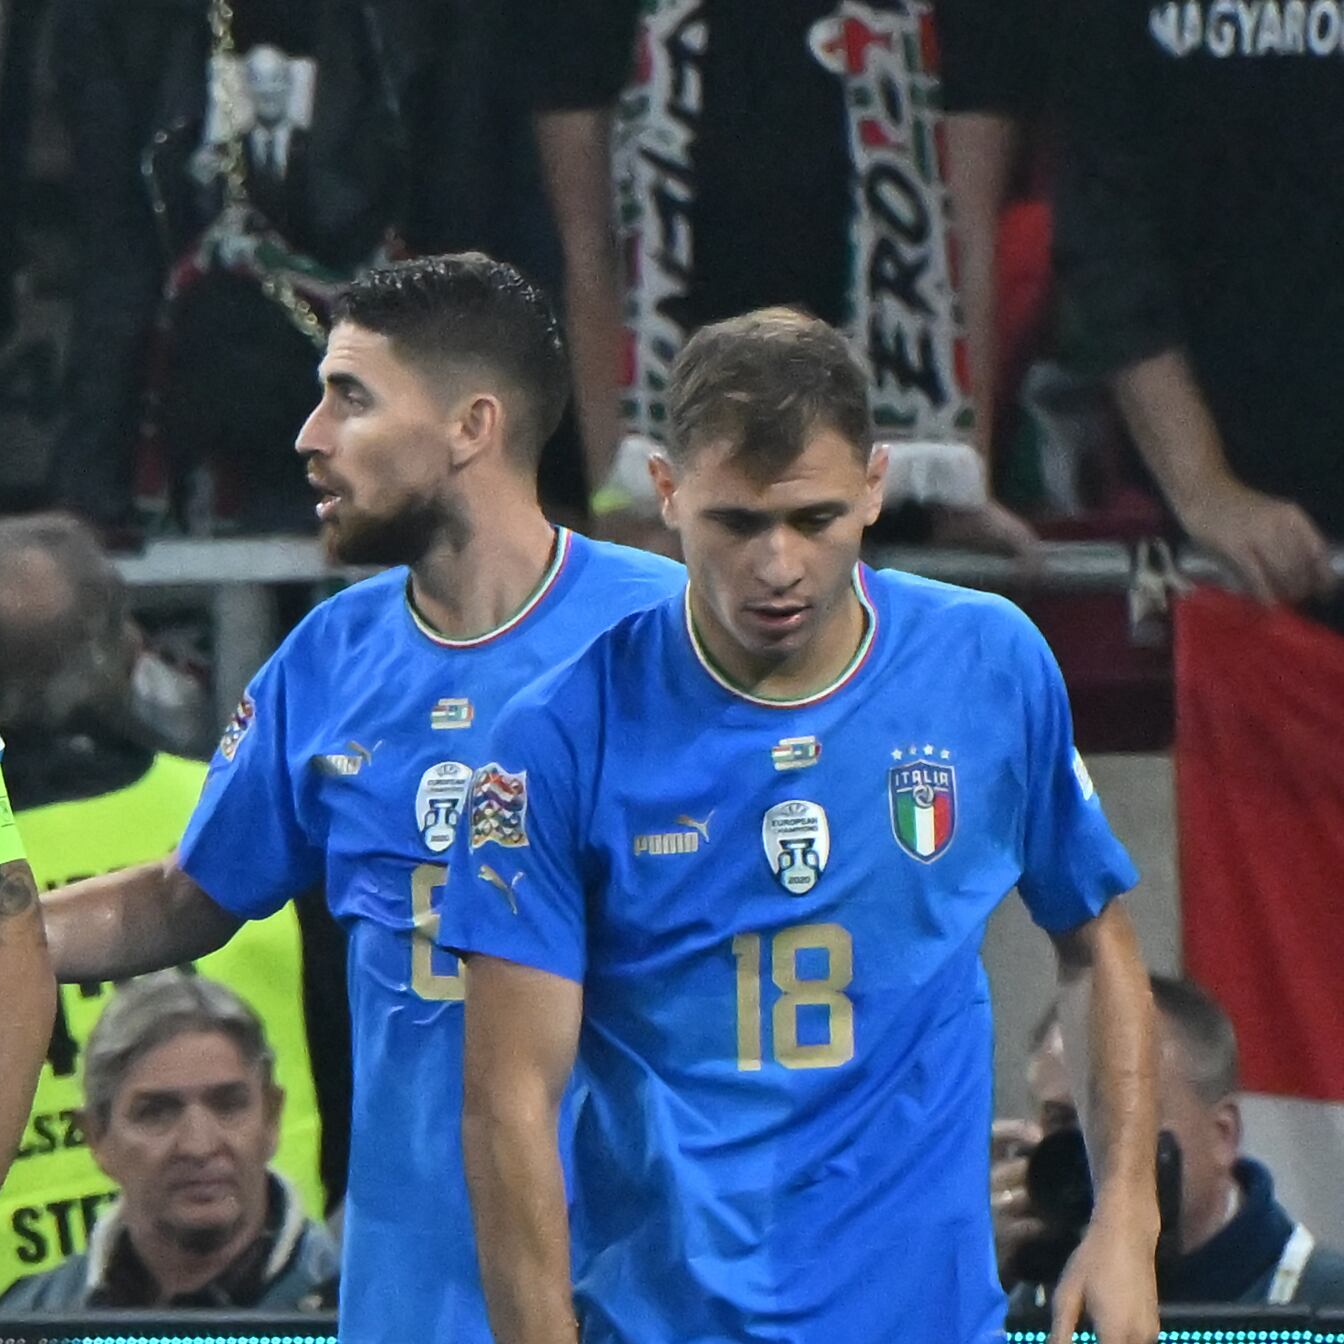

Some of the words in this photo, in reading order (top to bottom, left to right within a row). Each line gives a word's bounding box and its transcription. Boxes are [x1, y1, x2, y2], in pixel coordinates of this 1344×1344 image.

[895, 769, 949, 787] ITALIA
[633, 831, 699, 857] PUMA
[731, 922, 857, 1072] 18
